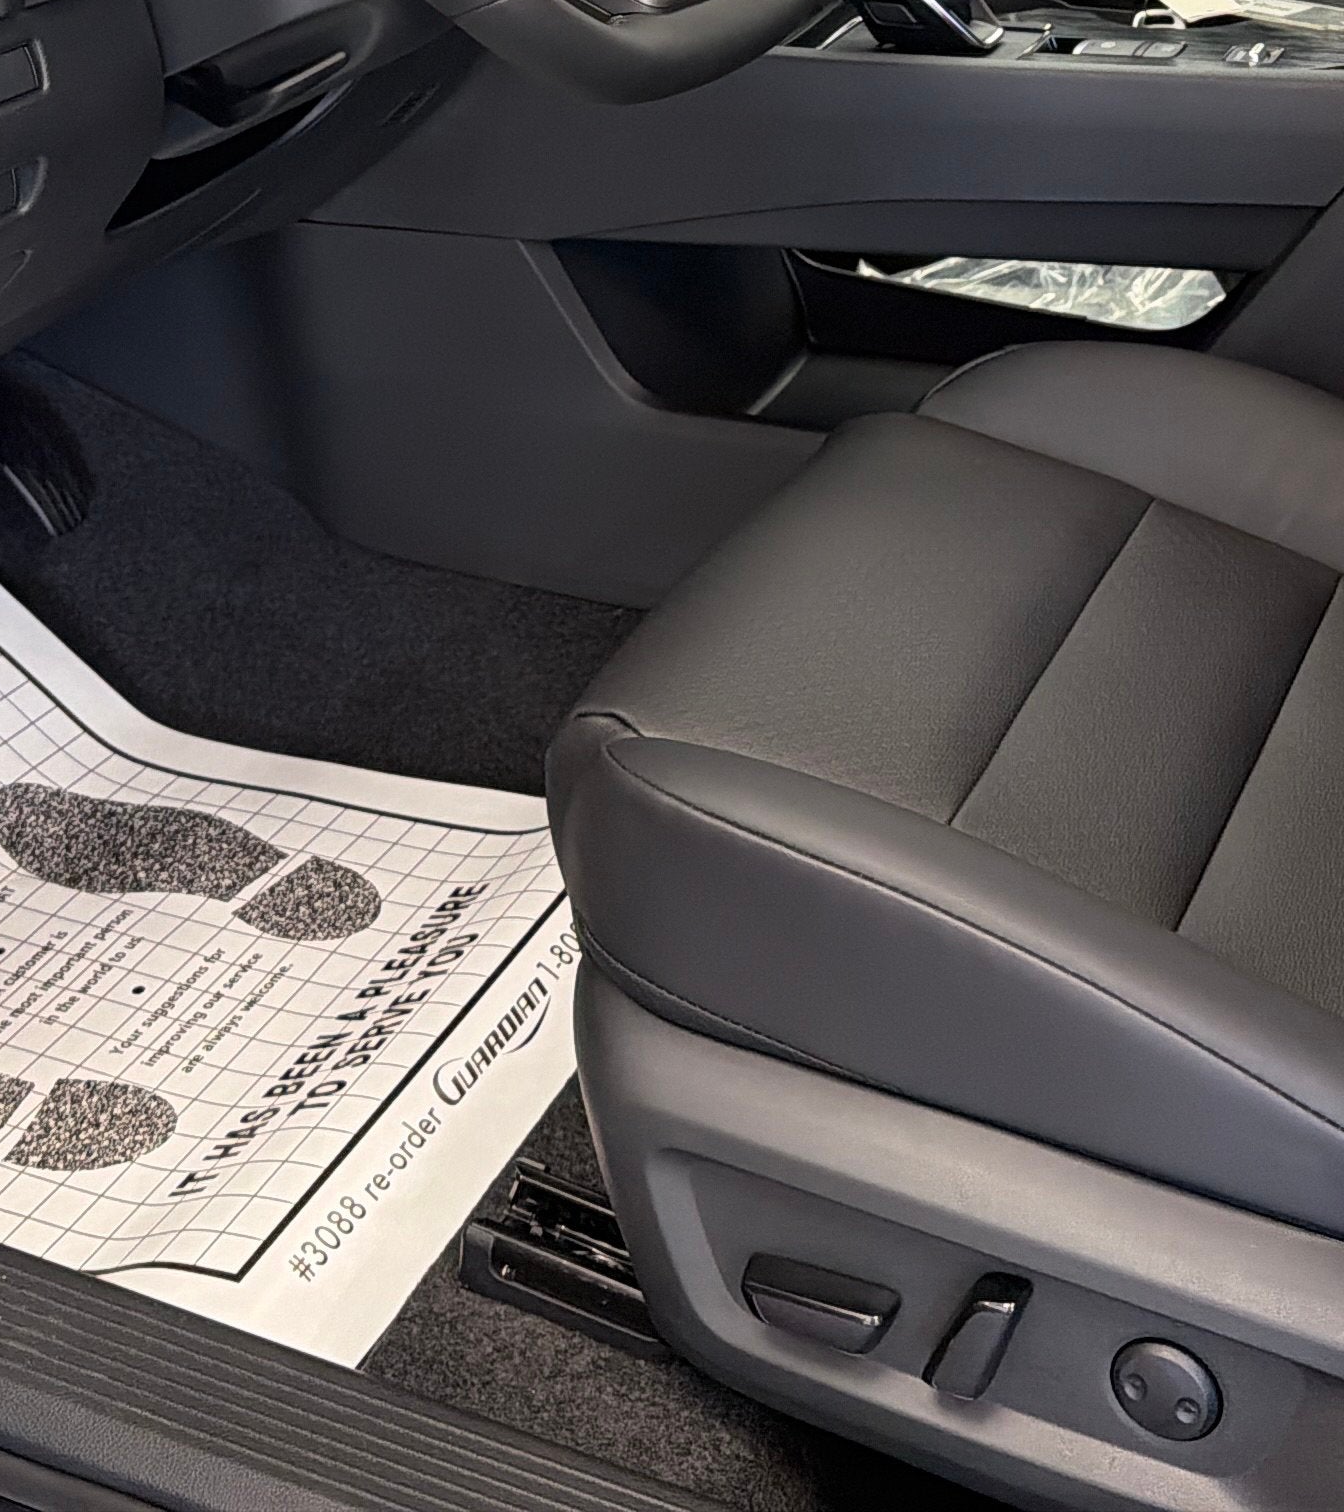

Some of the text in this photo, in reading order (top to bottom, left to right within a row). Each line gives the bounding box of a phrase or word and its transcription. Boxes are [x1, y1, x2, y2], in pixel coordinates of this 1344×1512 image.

[3, 940, 56, 986] customer
[50, 930, 69, 940] is
[9, 992, 43, 1018] most
[35, 941, 97, 991] important
[93, 909, 134, 941] person
[39, 1014, 60, 1025] in
[55, 995, 81, 1013] the
[78, 962, 113, 994] world
[108, 951, 126, 963] to
[109, 948, 226, 1056] Your suggestions for
[140, 952, 263, 1068] improving our service
[168, 882, 491, 1198] IT HAS BEEN A PLEASURE
[182, 963, 294, 1073] are always welcome.
[287, 932, 480, 1116] TO SERVE YOU
[288, 1194, 368, 1282] #3088
[363, 1106, 443, 1202] re-order
